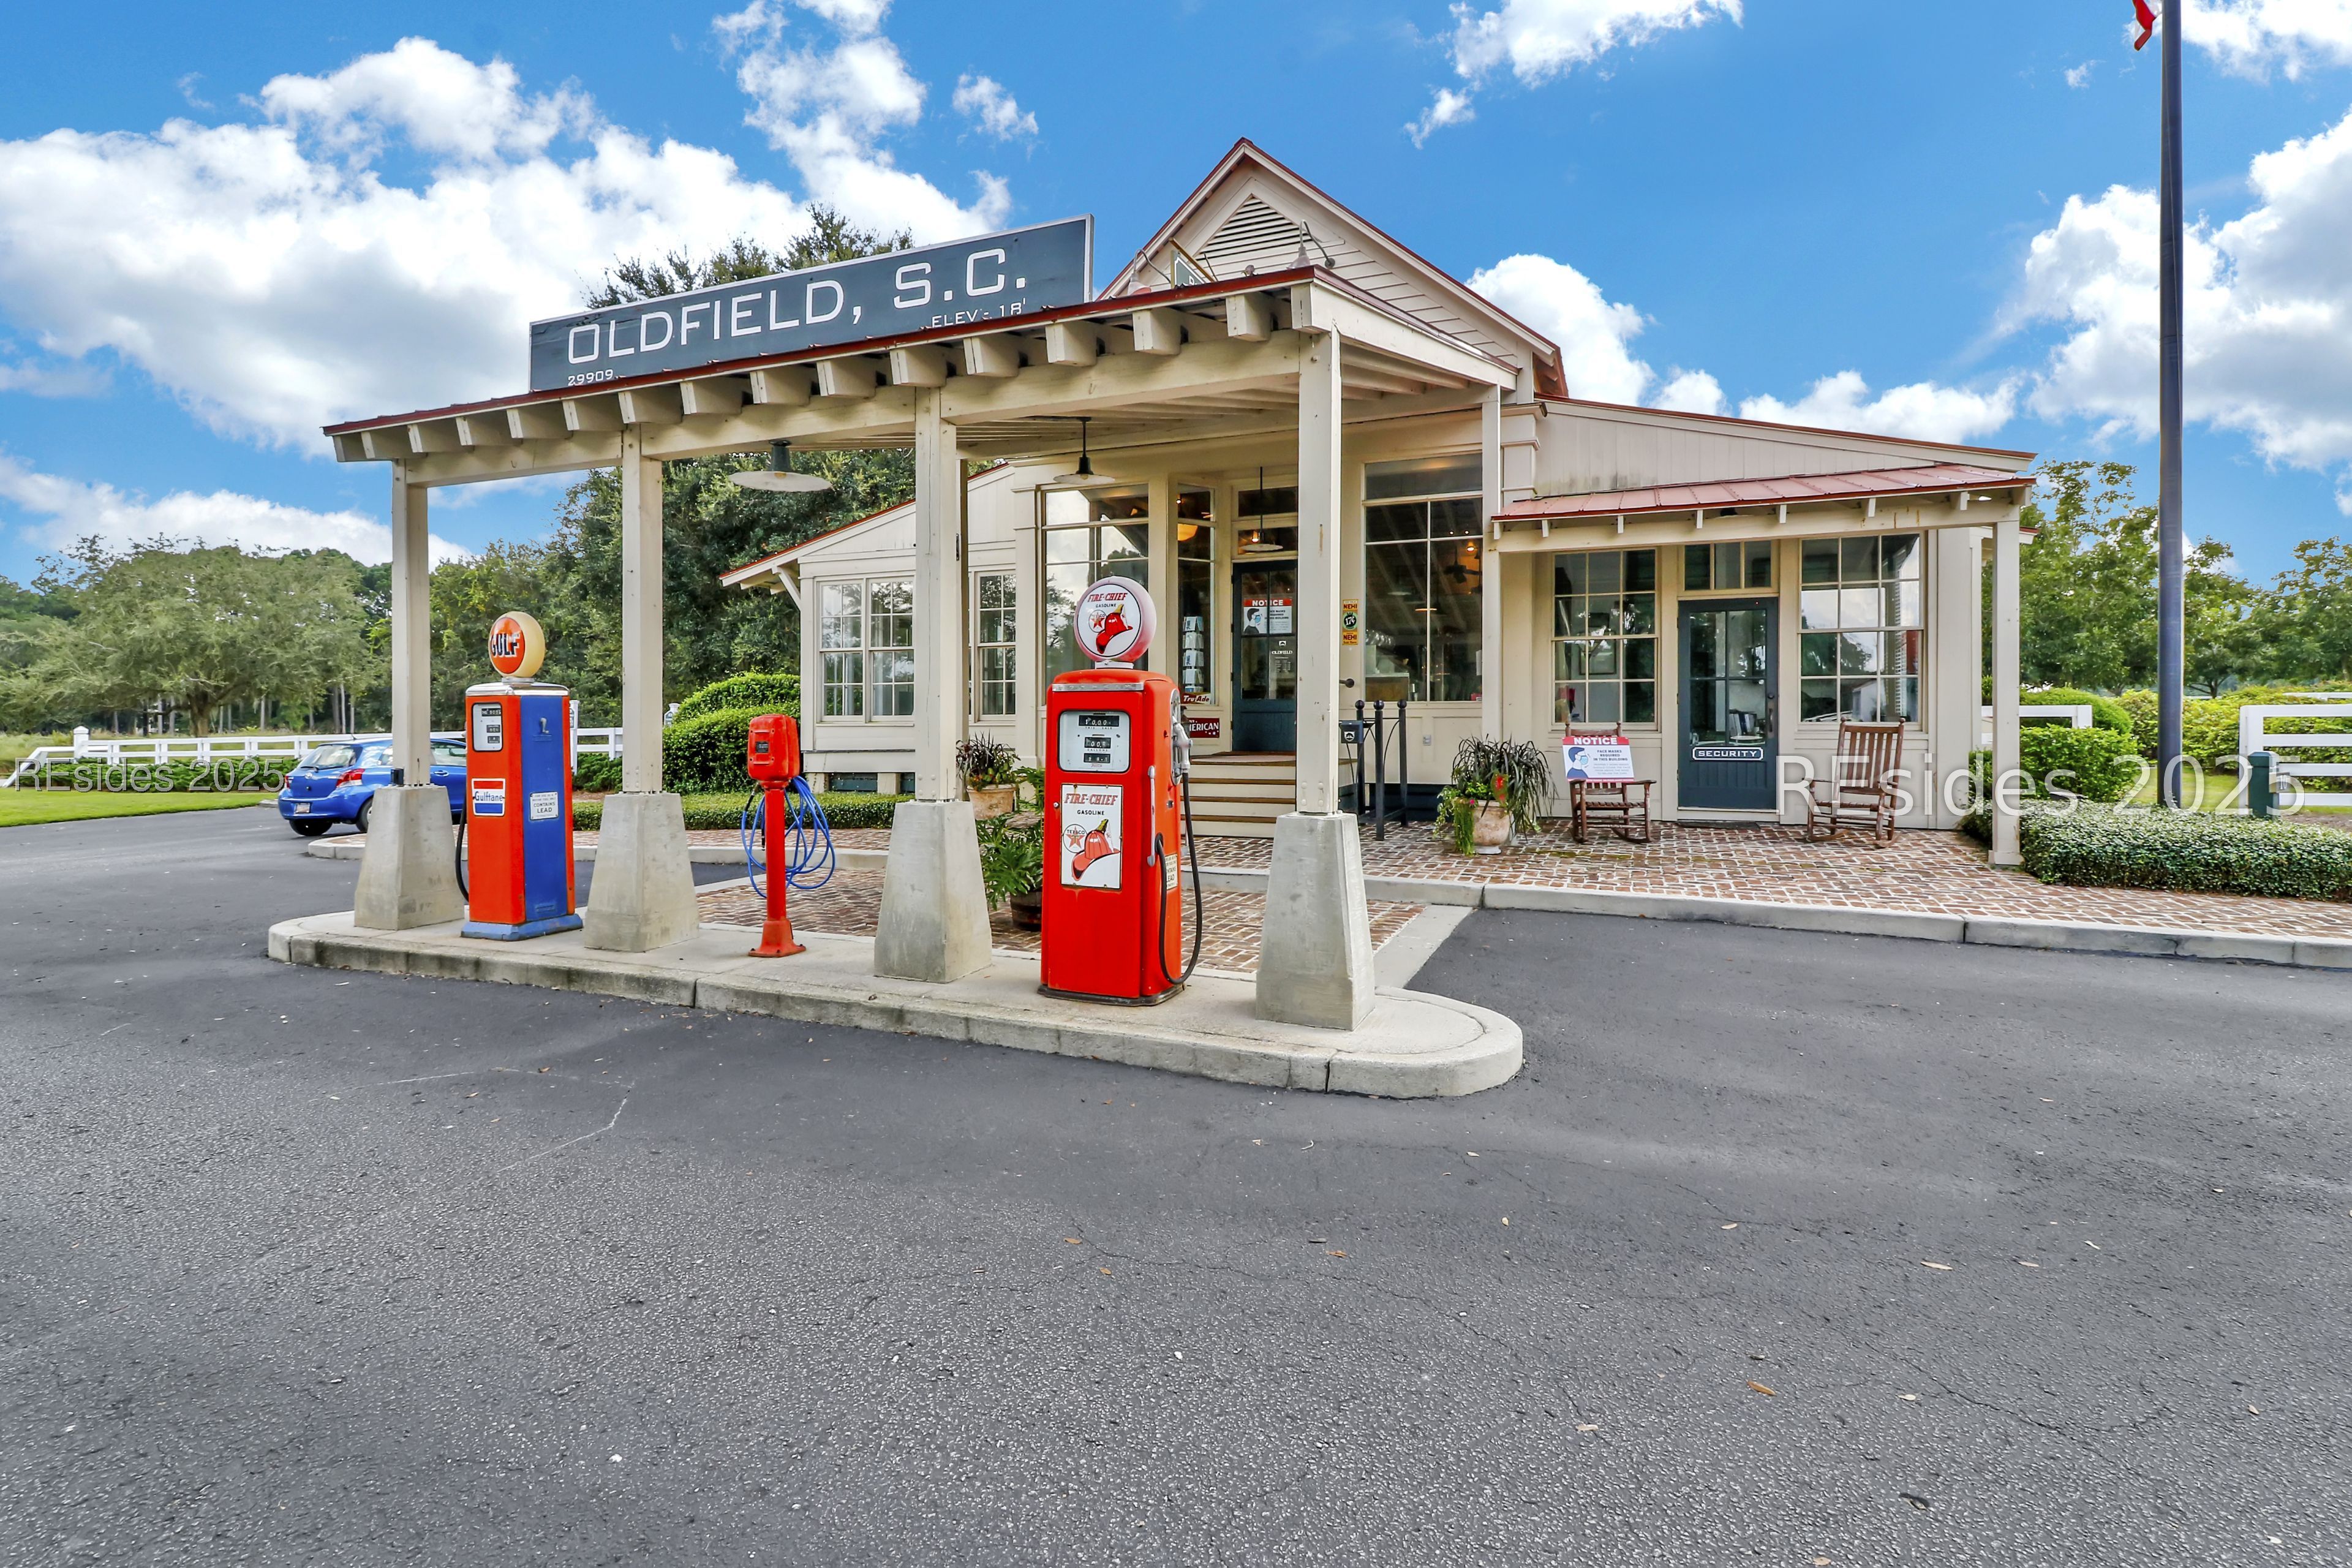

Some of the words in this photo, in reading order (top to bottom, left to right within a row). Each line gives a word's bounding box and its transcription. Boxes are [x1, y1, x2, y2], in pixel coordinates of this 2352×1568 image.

[568, 280, 861, 364] OLDFIELD,
[894, 248, 1025, 309] S.C.
[568, 369, 613, 386] 29909
[1088, 593, 1128, 602] FIRE-CHIEF
[491, 632, 520, 657] GULF
[1189, 722, 1219, 731] ERICAN
[1065, 793, 1118, 805] FIRE-CHIEF
